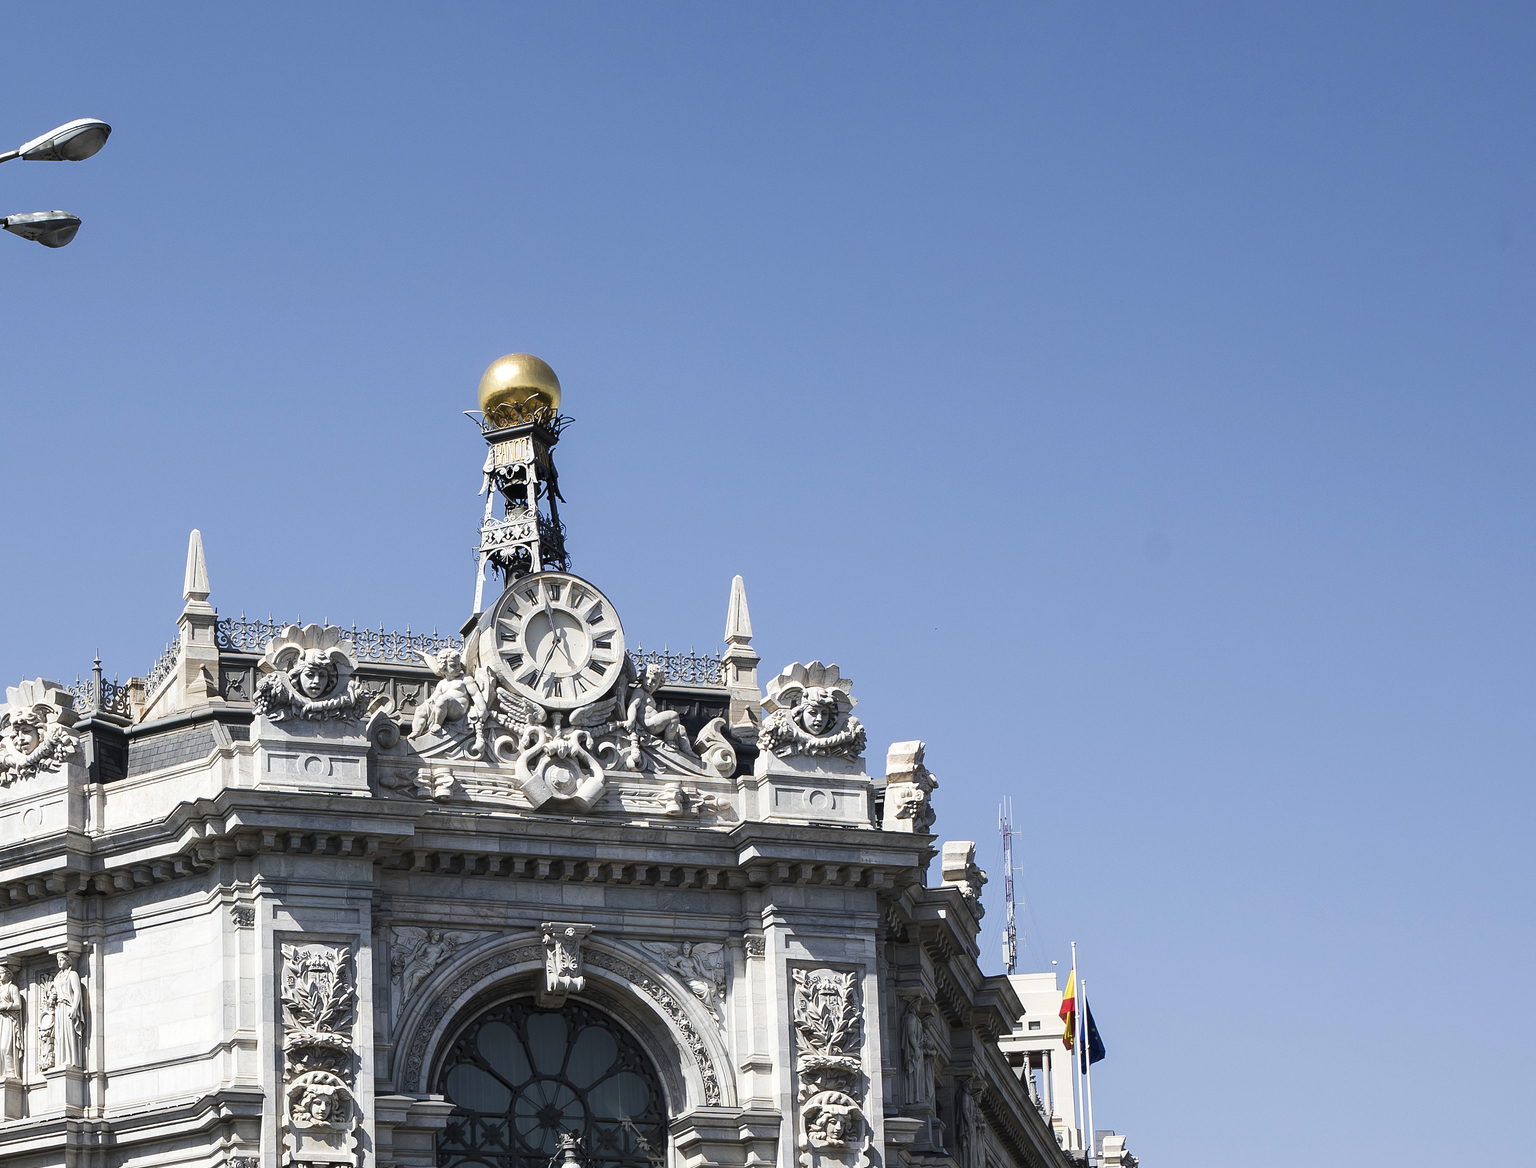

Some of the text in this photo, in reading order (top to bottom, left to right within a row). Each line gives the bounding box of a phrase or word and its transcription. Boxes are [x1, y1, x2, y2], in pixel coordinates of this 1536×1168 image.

[525, 589, 538, 605] XI
[575, 595, 584, 608] I
[508, 607, 522, 620] X
[589, 616, 604, 625] II
[501, 633, 516, 641] IX
[596, 641, 611, 649] III
[507, 655, 523, 670] VIII
[577, 678, 587, 693] V
